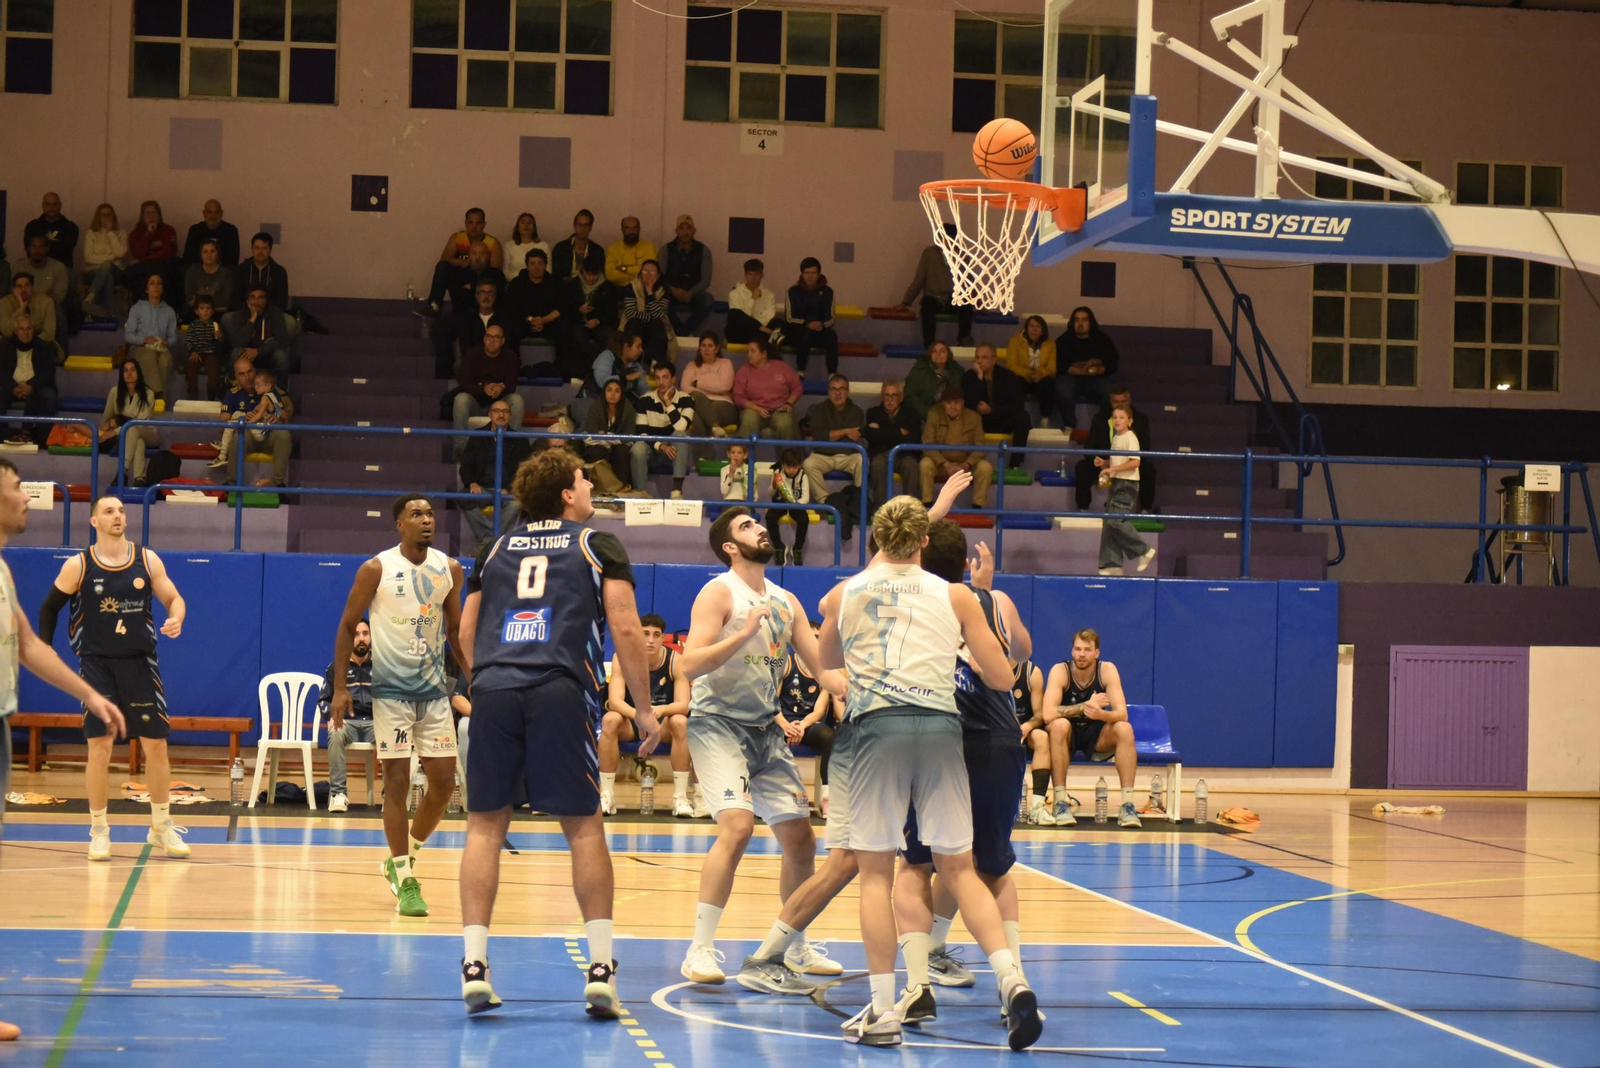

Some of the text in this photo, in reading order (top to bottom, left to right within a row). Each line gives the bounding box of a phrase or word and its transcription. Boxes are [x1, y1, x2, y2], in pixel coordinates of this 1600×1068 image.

[747, 128, 778, 137] SECTOR
[758, 139, 766, 150] 4
[1171, 208, 1351, 238] SPORT SYSTEM
[517, 555, 549, 599] 0
[882, 583, 924, 595] MURGI
[115, 619, 127, 635] 4
[505, 622, 546, 641] UBAGO
[407, 637, 427, 656] 35
[876, 604, 912, 670] 7
